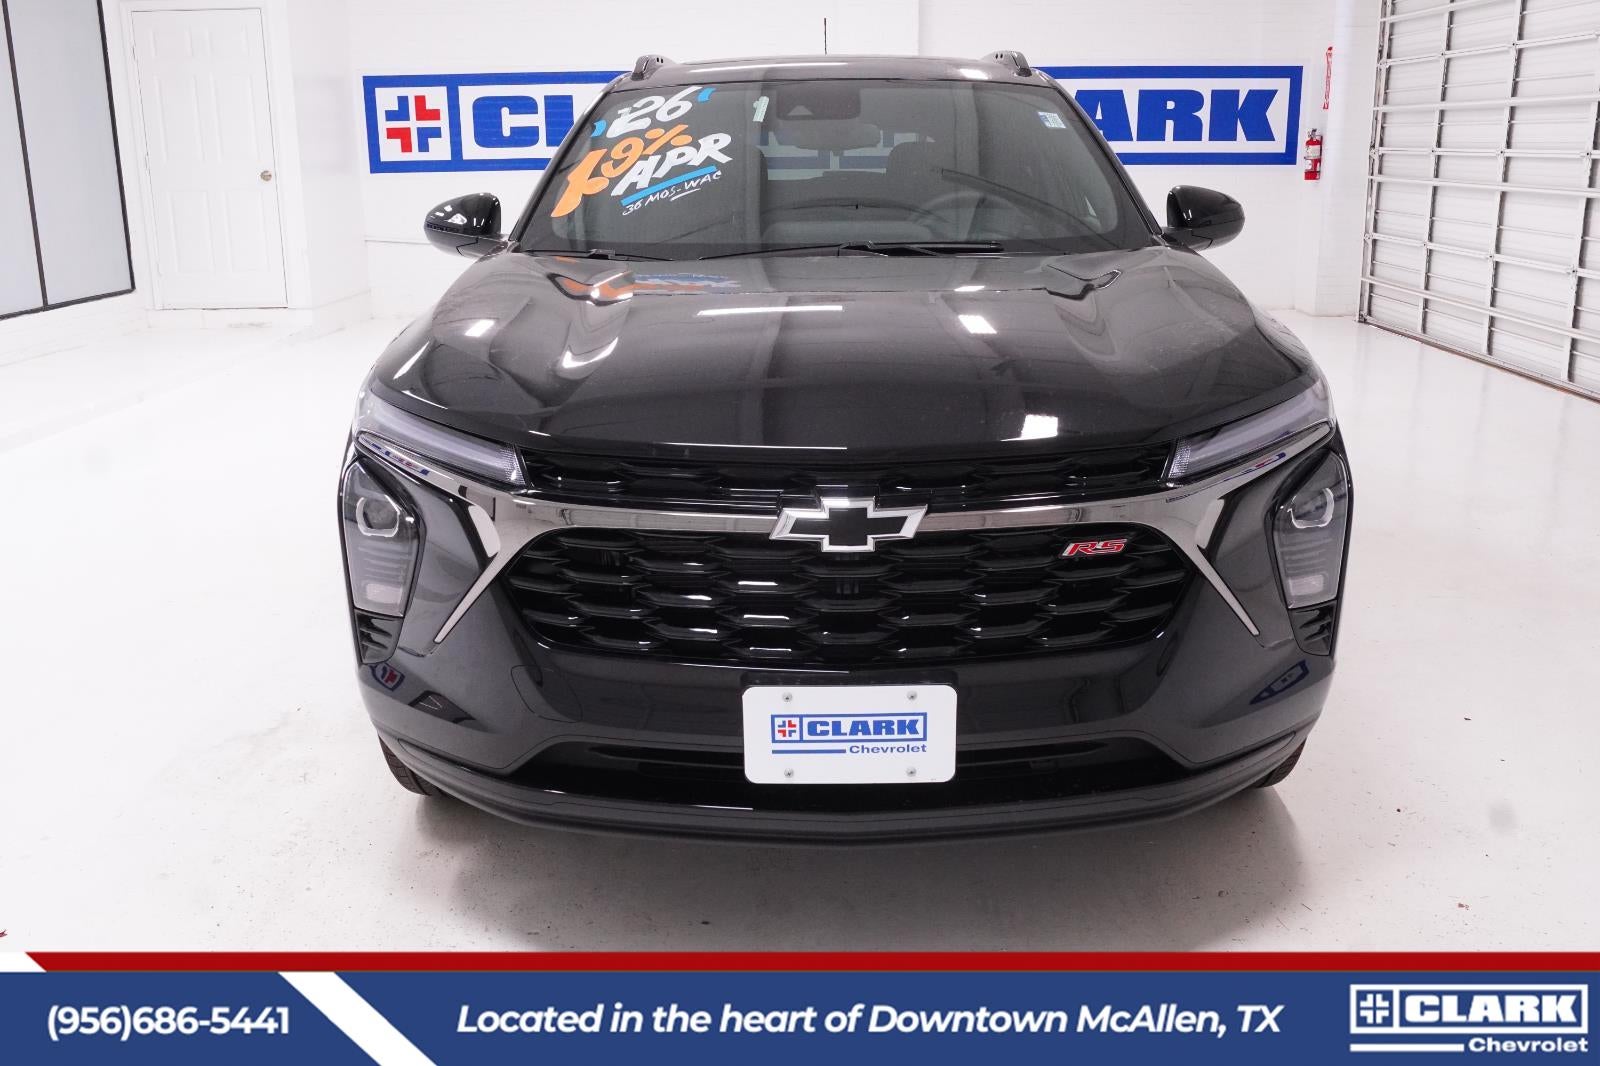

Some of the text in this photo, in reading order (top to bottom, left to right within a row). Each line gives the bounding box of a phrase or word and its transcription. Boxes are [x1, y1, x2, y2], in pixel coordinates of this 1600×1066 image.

[1074, 89, 1279, 141] ARK
[610, 132, 733, 197] APR
[1062, 539, 1127, 556] RS
[807, 719, 919, 736] CLARK
[849, 743, 927, 755] Chevrolet
